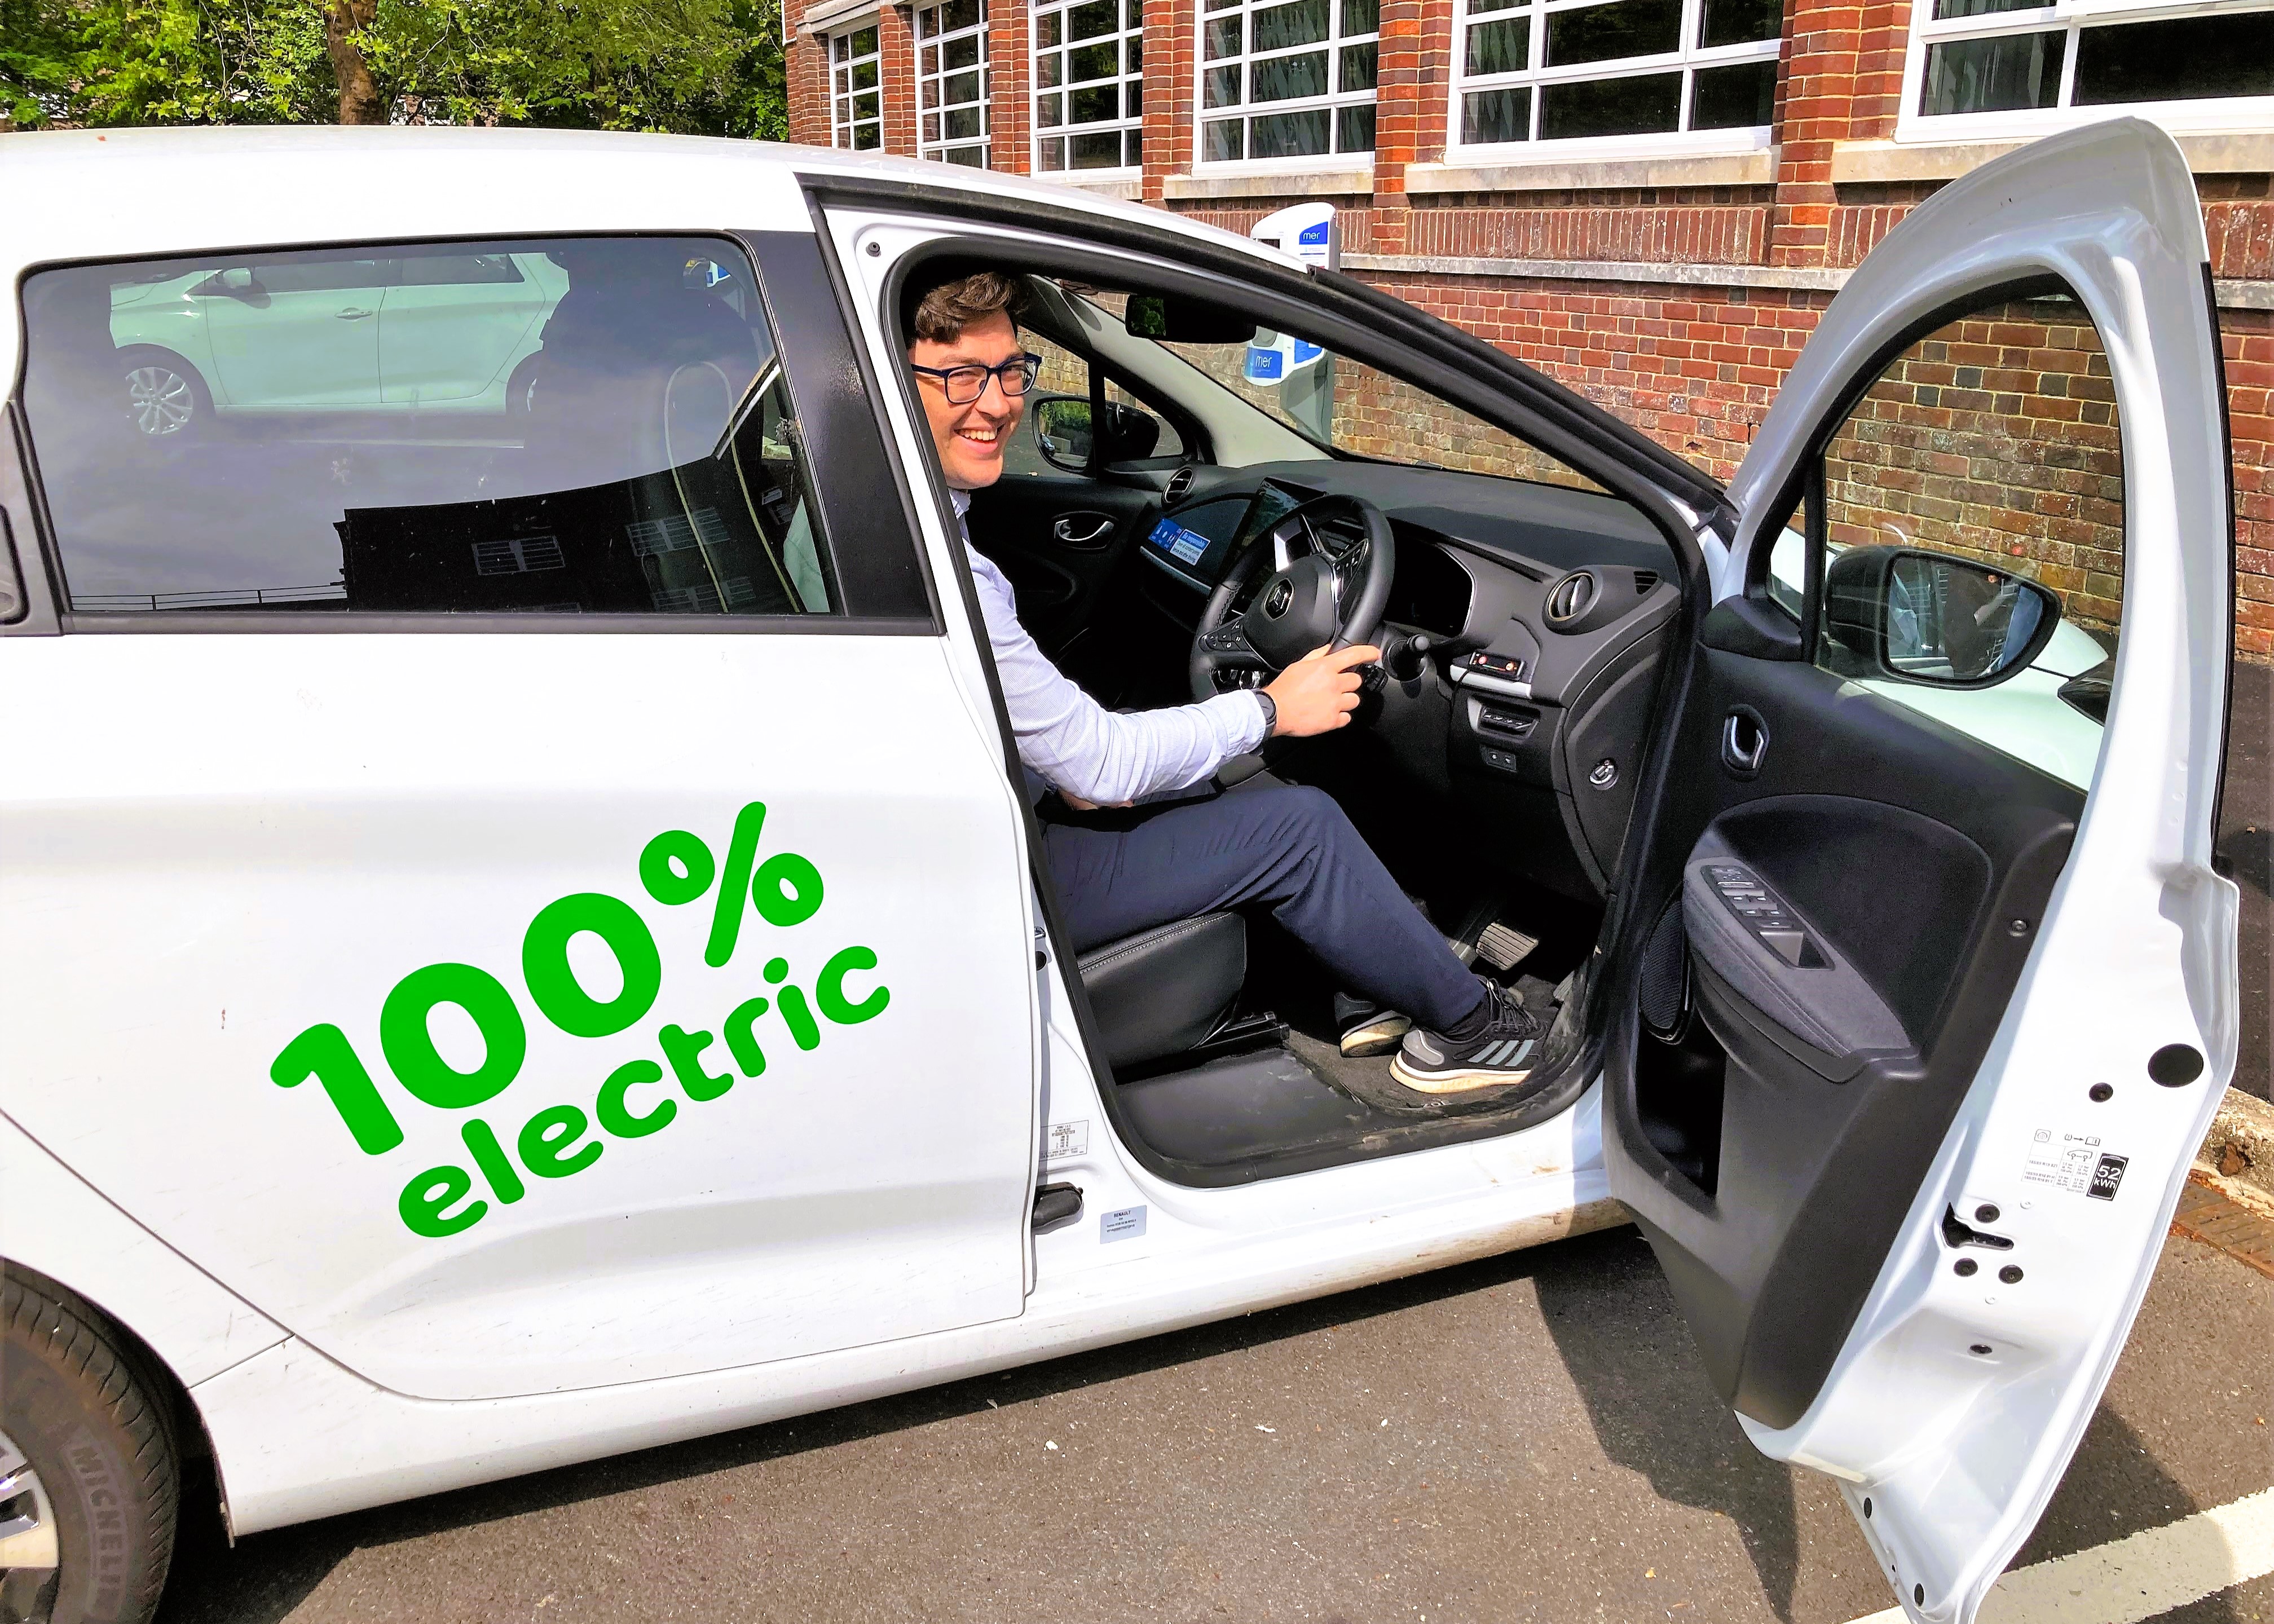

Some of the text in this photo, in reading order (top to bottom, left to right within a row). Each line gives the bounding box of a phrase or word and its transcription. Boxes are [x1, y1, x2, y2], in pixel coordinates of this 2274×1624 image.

[1255, 356, 1272, 368] mer
[270, 801, 823, 1155] 100%
[399, 946, 890, 1238] electric
[2097, 1165, 2121, 1180] 52
[2094, 1177, 2116, 1189] kWh
